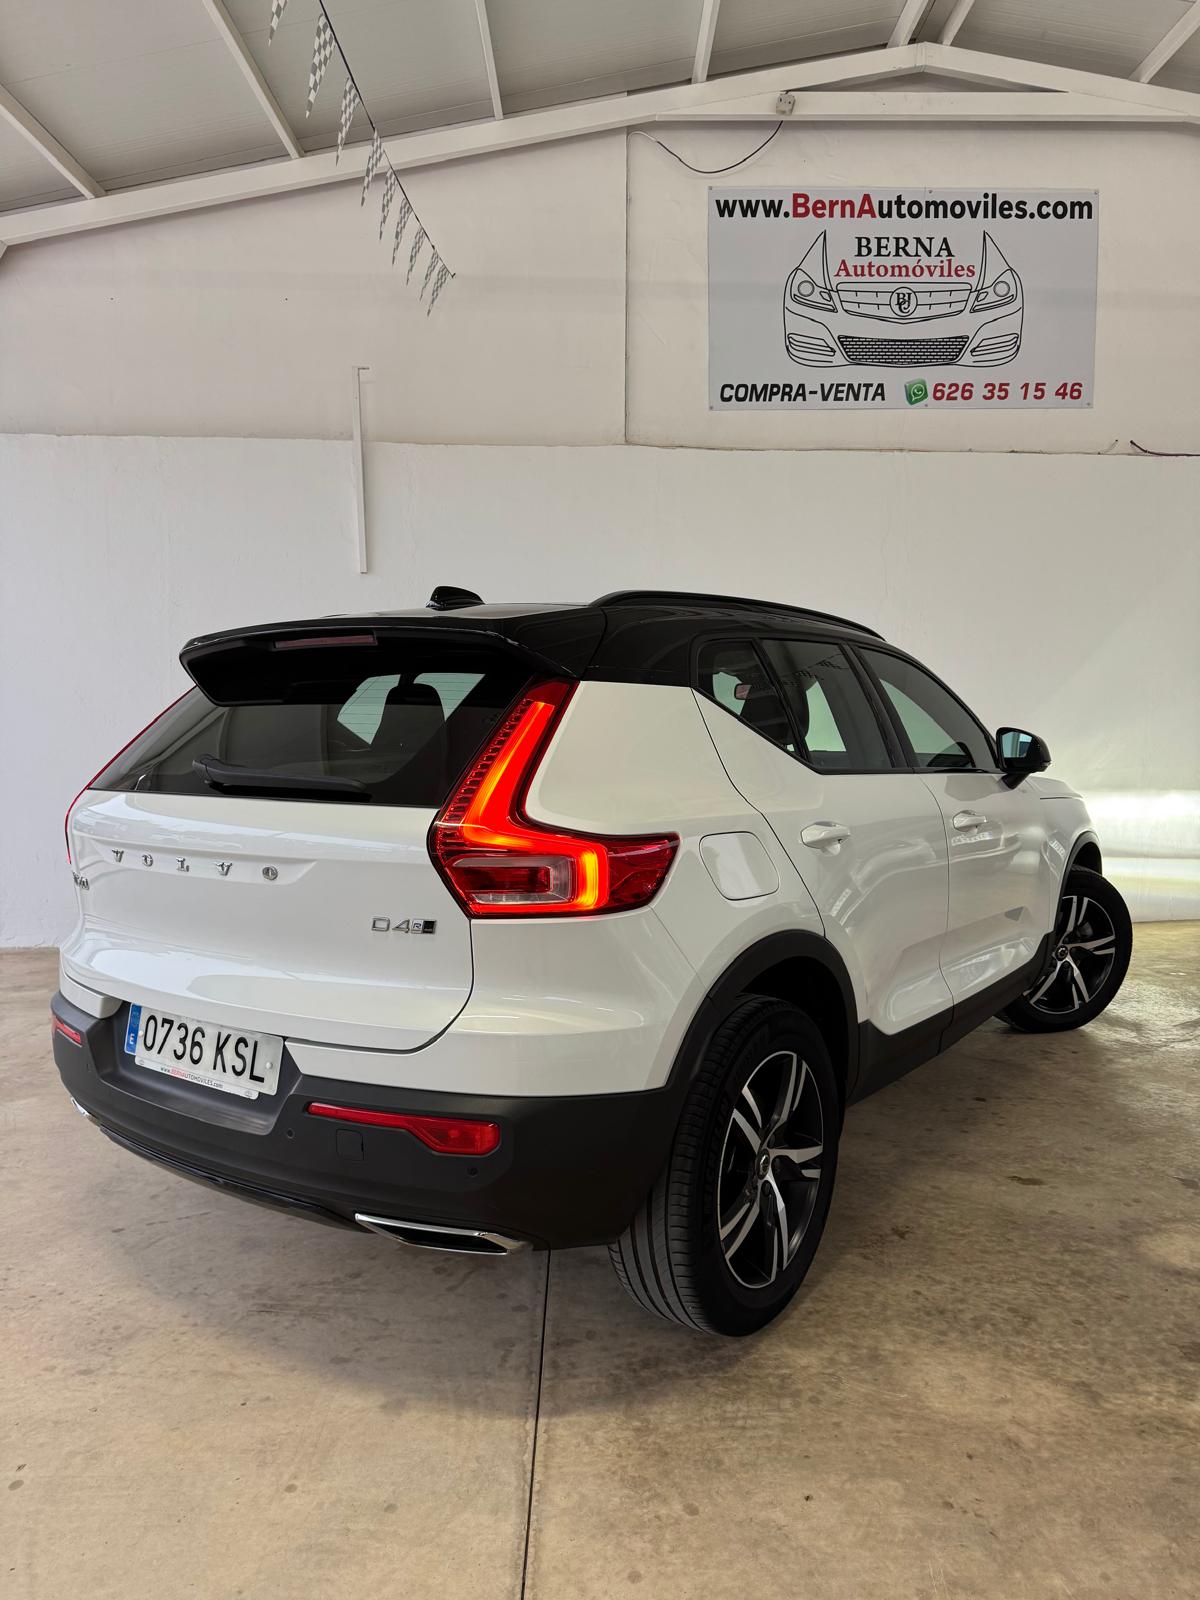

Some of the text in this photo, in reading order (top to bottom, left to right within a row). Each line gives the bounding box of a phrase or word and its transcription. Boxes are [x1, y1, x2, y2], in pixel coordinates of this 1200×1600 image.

[715, 192, 1093, 220] www.BernAutomoviles.com
[854, 236, 955, 258] BERNA
[834, 258, 976, 278] Automóviles
[720, 383, 886, 402] COMPRA-VENTA
[932, 382, 1083, 401] 626 35 15 46
[112, 849, 278, 881] VOLVO
[129, 1033, 135, 1045] E
[143, 1014, 265, 1083] 0736 KSL
